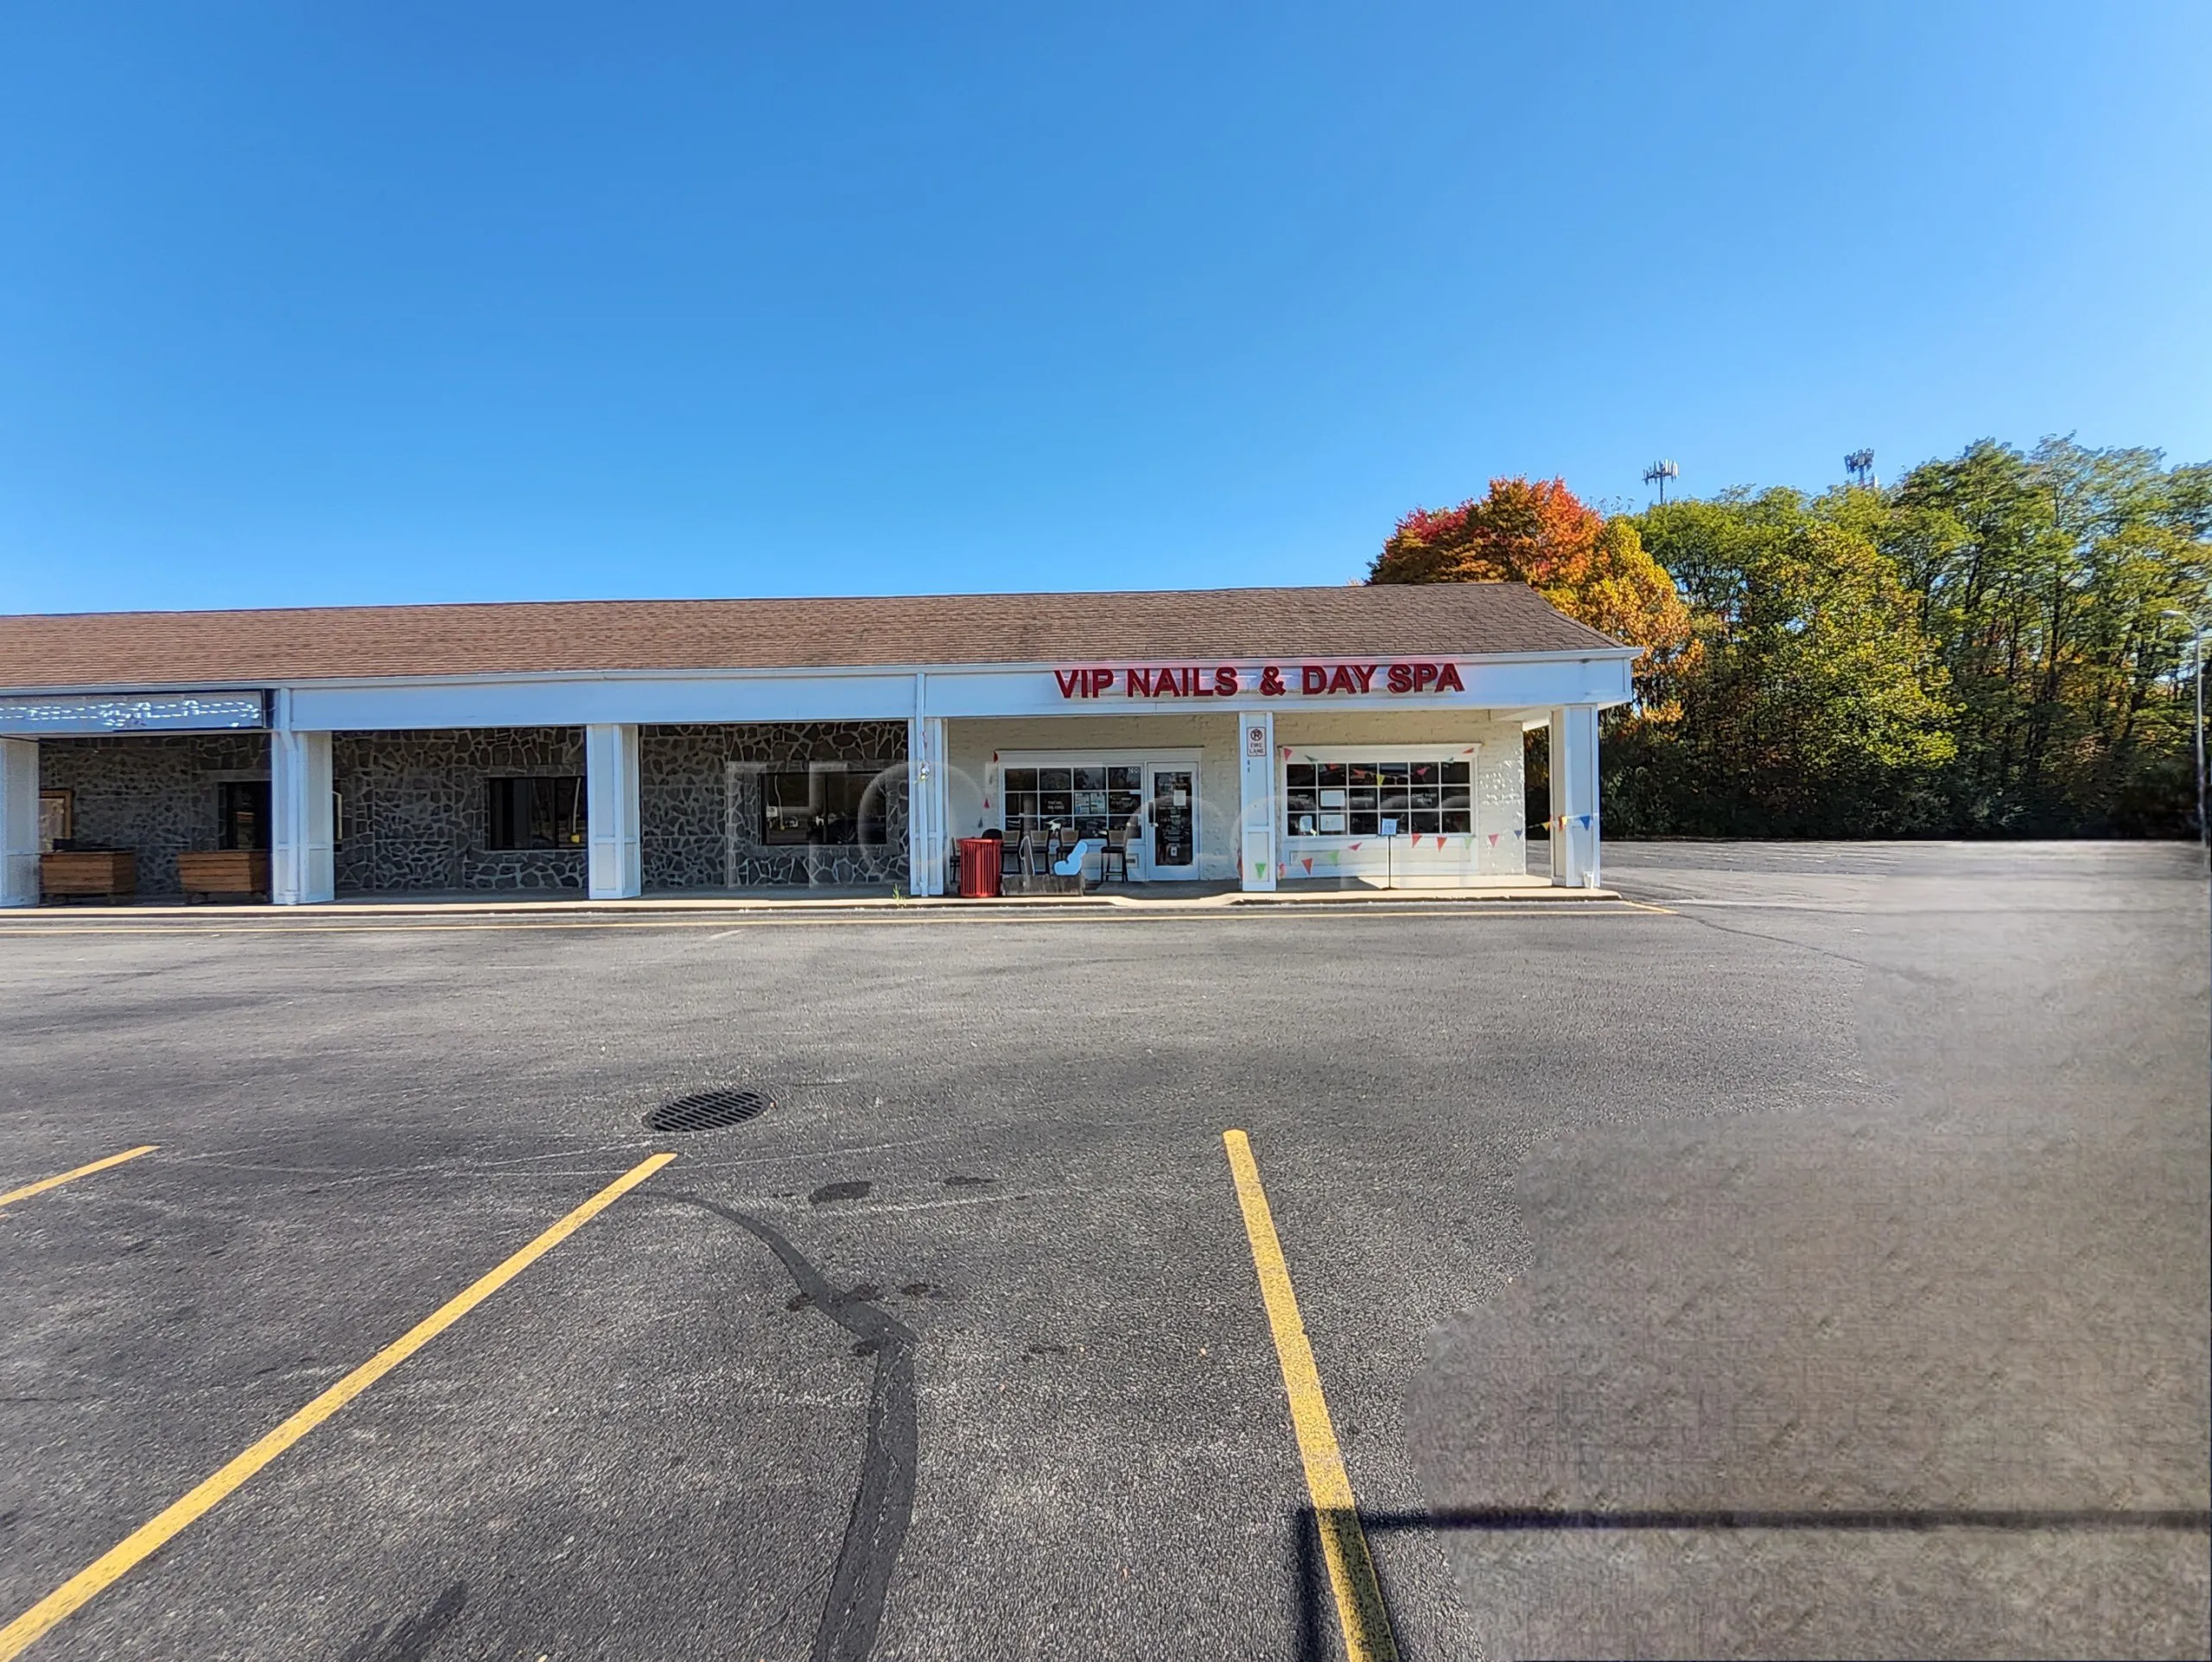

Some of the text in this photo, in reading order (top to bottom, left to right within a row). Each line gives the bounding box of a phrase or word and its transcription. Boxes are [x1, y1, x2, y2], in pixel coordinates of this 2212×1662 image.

[1053, 663, 1465, 699] VIP NAILS & DAY SPA
